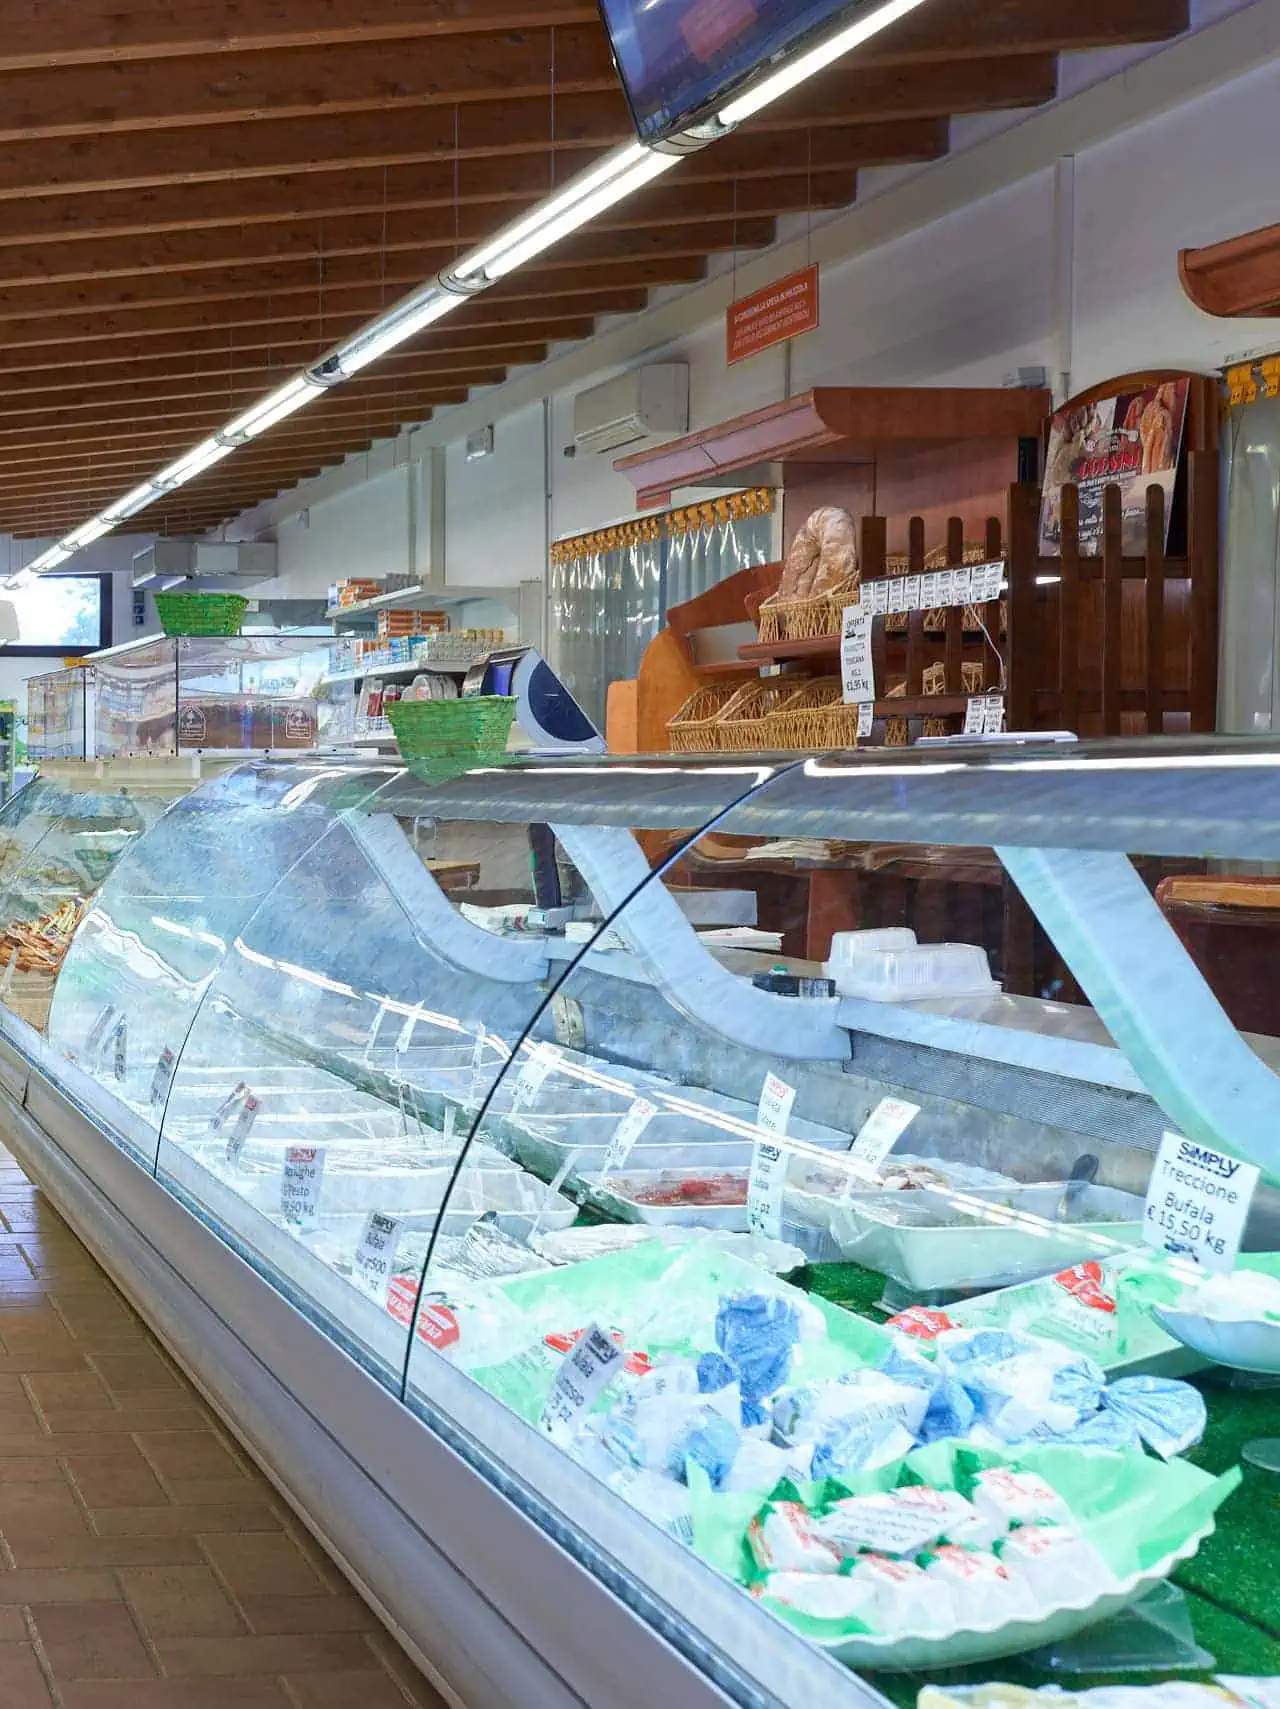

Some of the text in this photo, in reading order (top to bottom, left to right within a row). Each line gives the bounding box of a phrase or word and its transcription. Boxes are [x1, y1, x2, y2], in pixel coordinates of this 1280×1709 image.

[1160, 1159, 1238, 1204] Treccione
[1164, 1191, 1214, 1225] Bufala
[1159, 1209, 1201, 1241] 15,50
[1204, 1229, 1226, 1255] kg
